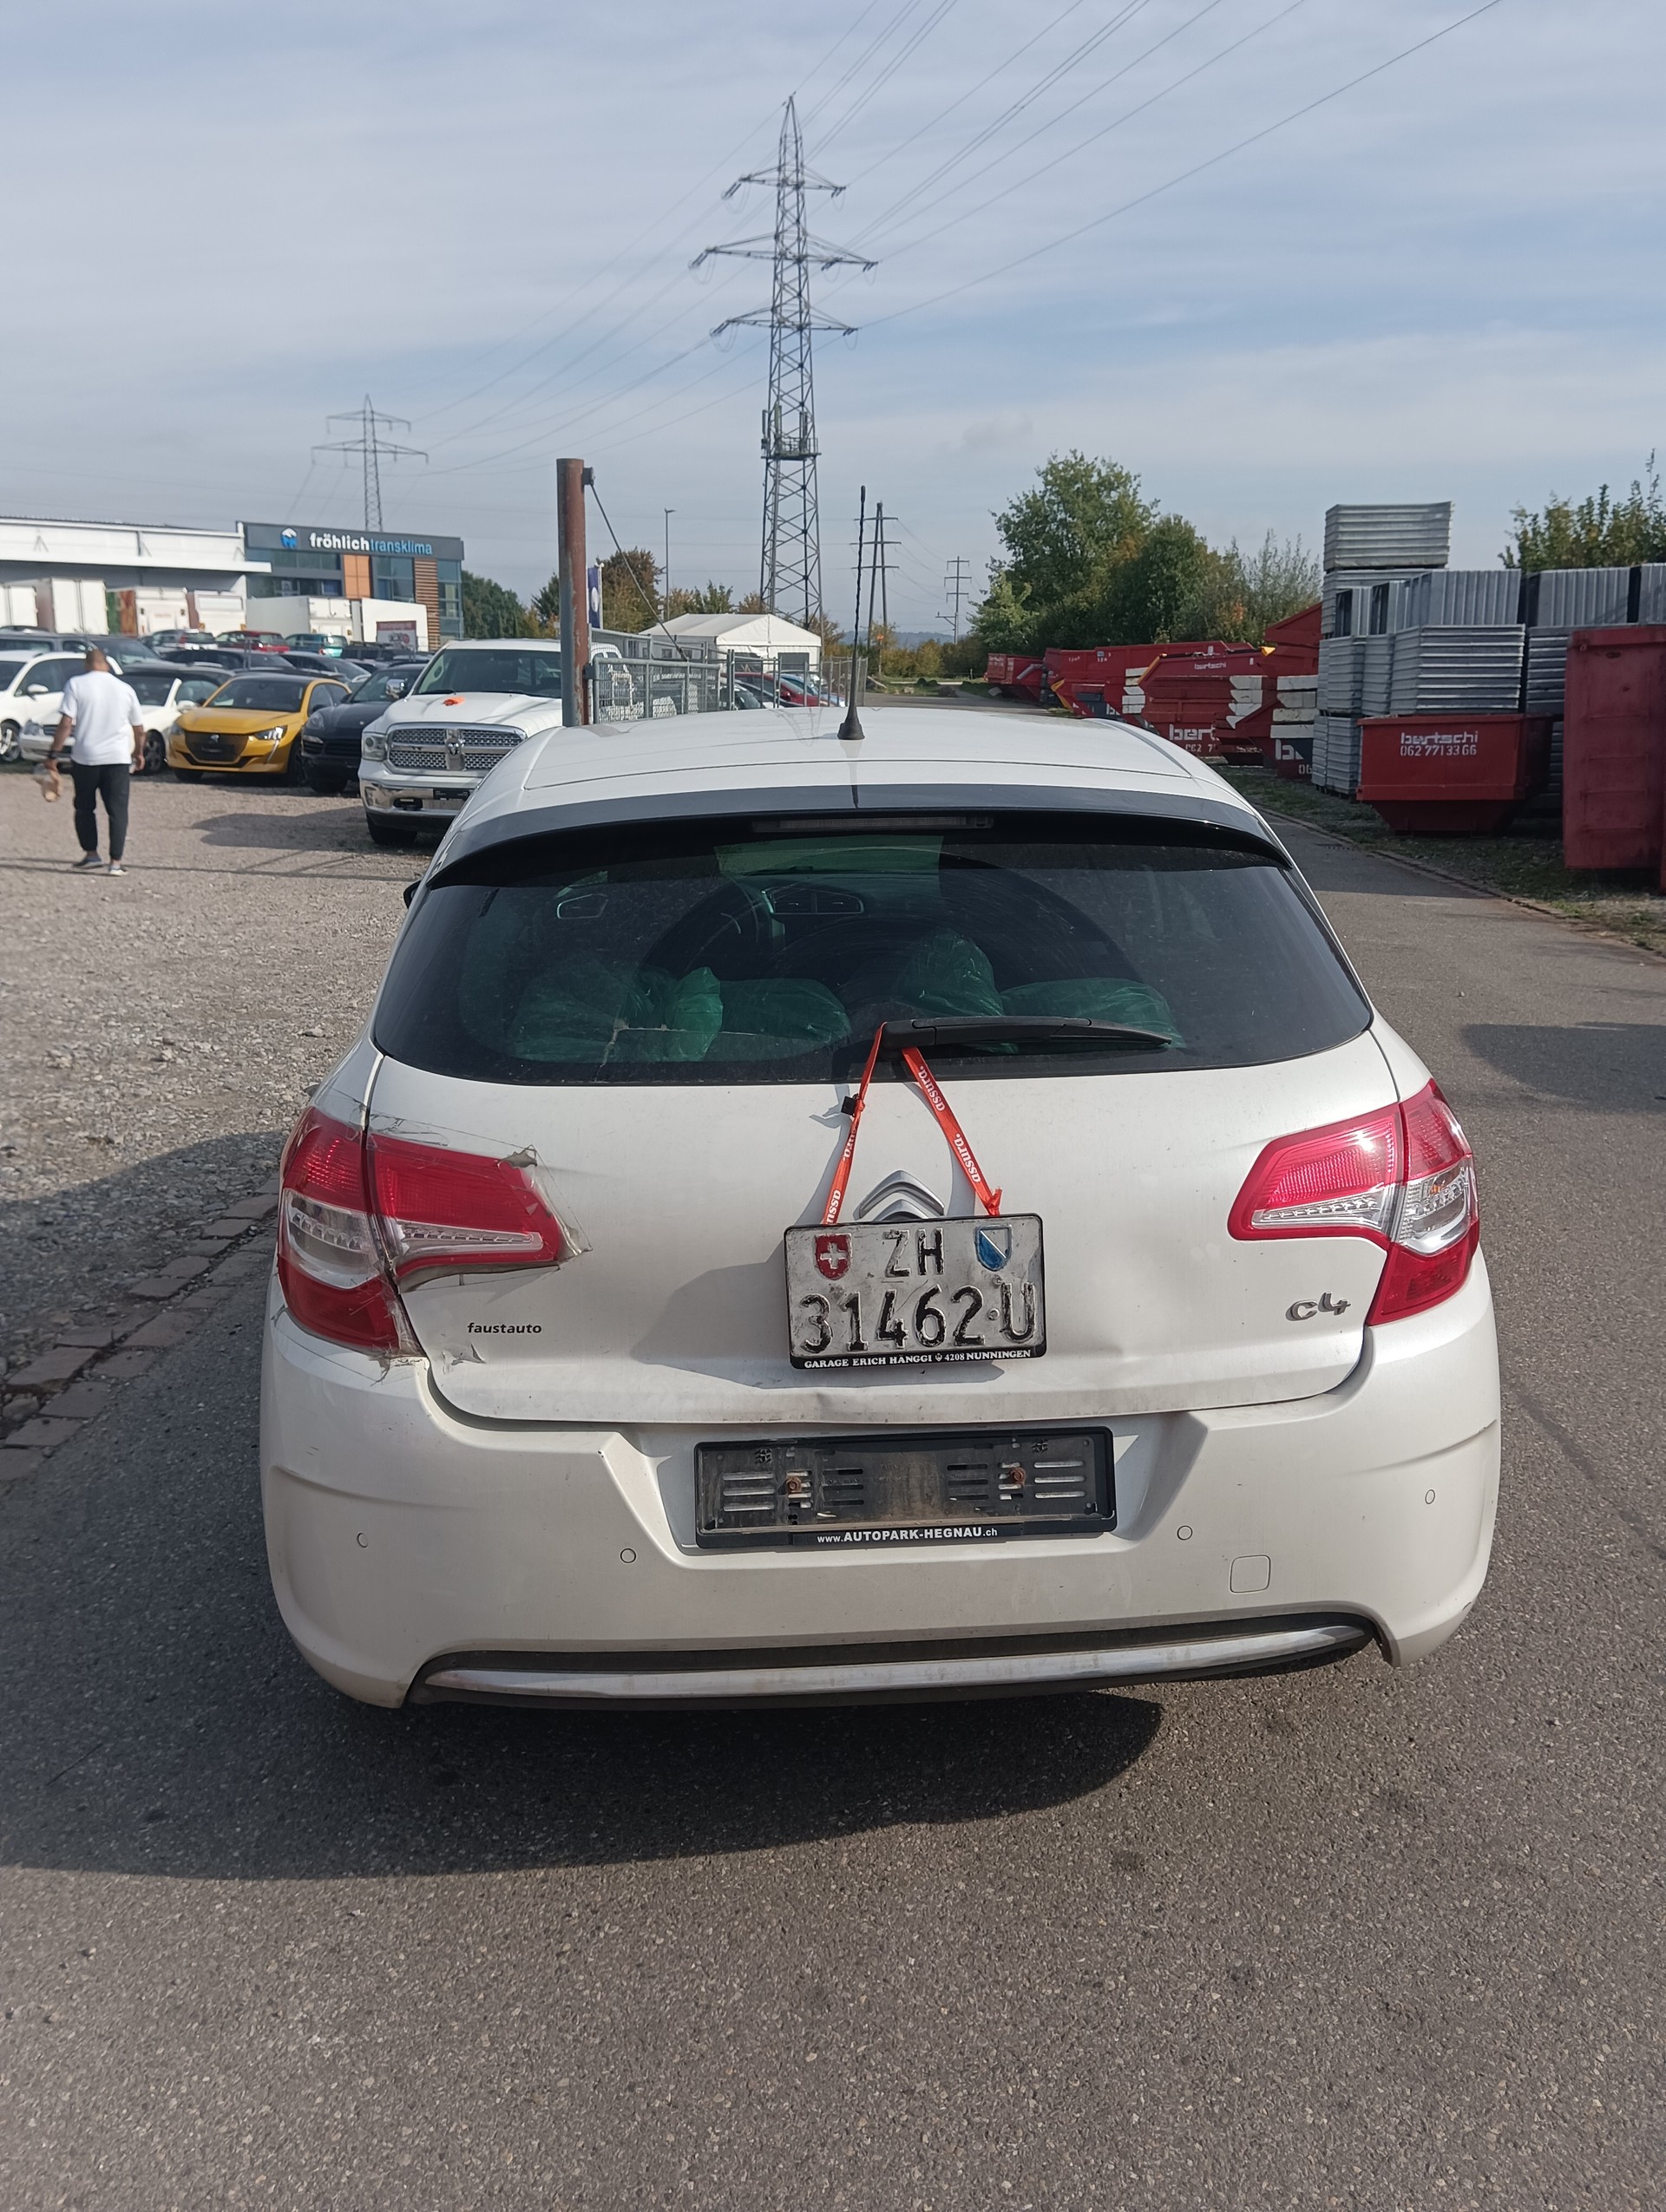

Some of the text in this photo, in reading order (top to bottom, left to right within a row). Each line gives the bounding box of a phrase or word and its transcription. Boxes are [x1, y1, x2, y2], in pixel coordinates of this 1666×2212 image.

[1400, 730, 1479, 745] bertschi
[1400, 744, 1421, 756] 062
[1424, 744, 1444, 756] 771
[882, 1227, 945, 1278] ZH
[1285, 1292, 1352, 1322] C4
[467, 1322, 542, 1334] faustauto
[803, 1349, 1032, 1369] GARAGE ERICH HÄNGGI 4208 NUNNINGEN
[817, 1526, 998, 1544] www.AUTOPARK-HEGNAU.ch
